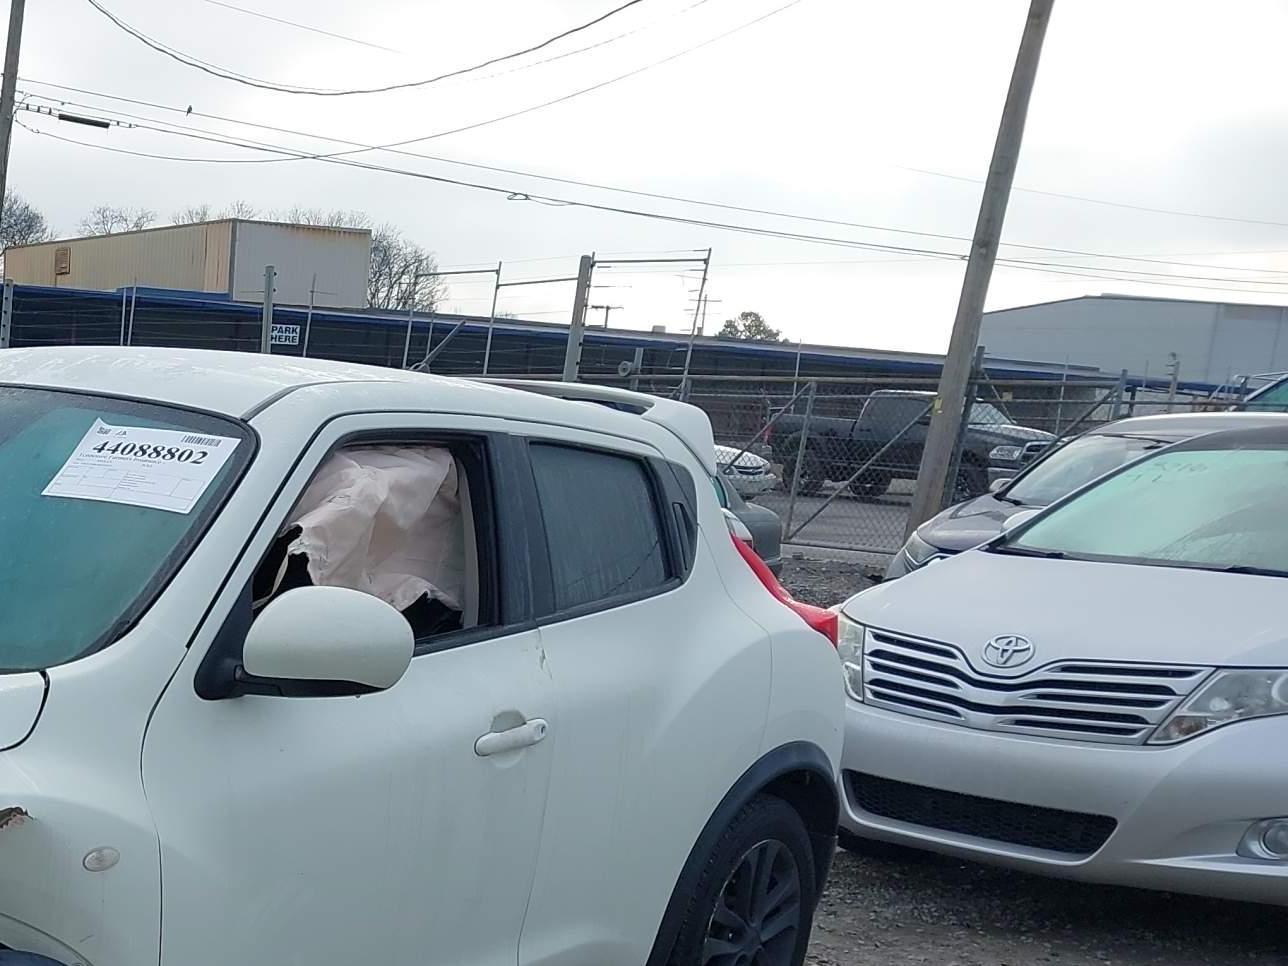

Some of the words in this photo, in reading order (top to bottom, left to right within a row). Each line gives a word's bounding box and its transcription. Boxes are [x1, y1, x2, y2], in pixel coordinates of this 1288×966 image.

[272, 326, 298, 335] PARK
[271, 335, 298, 343] HERE
[93, 440, 209, 464] 44088802
